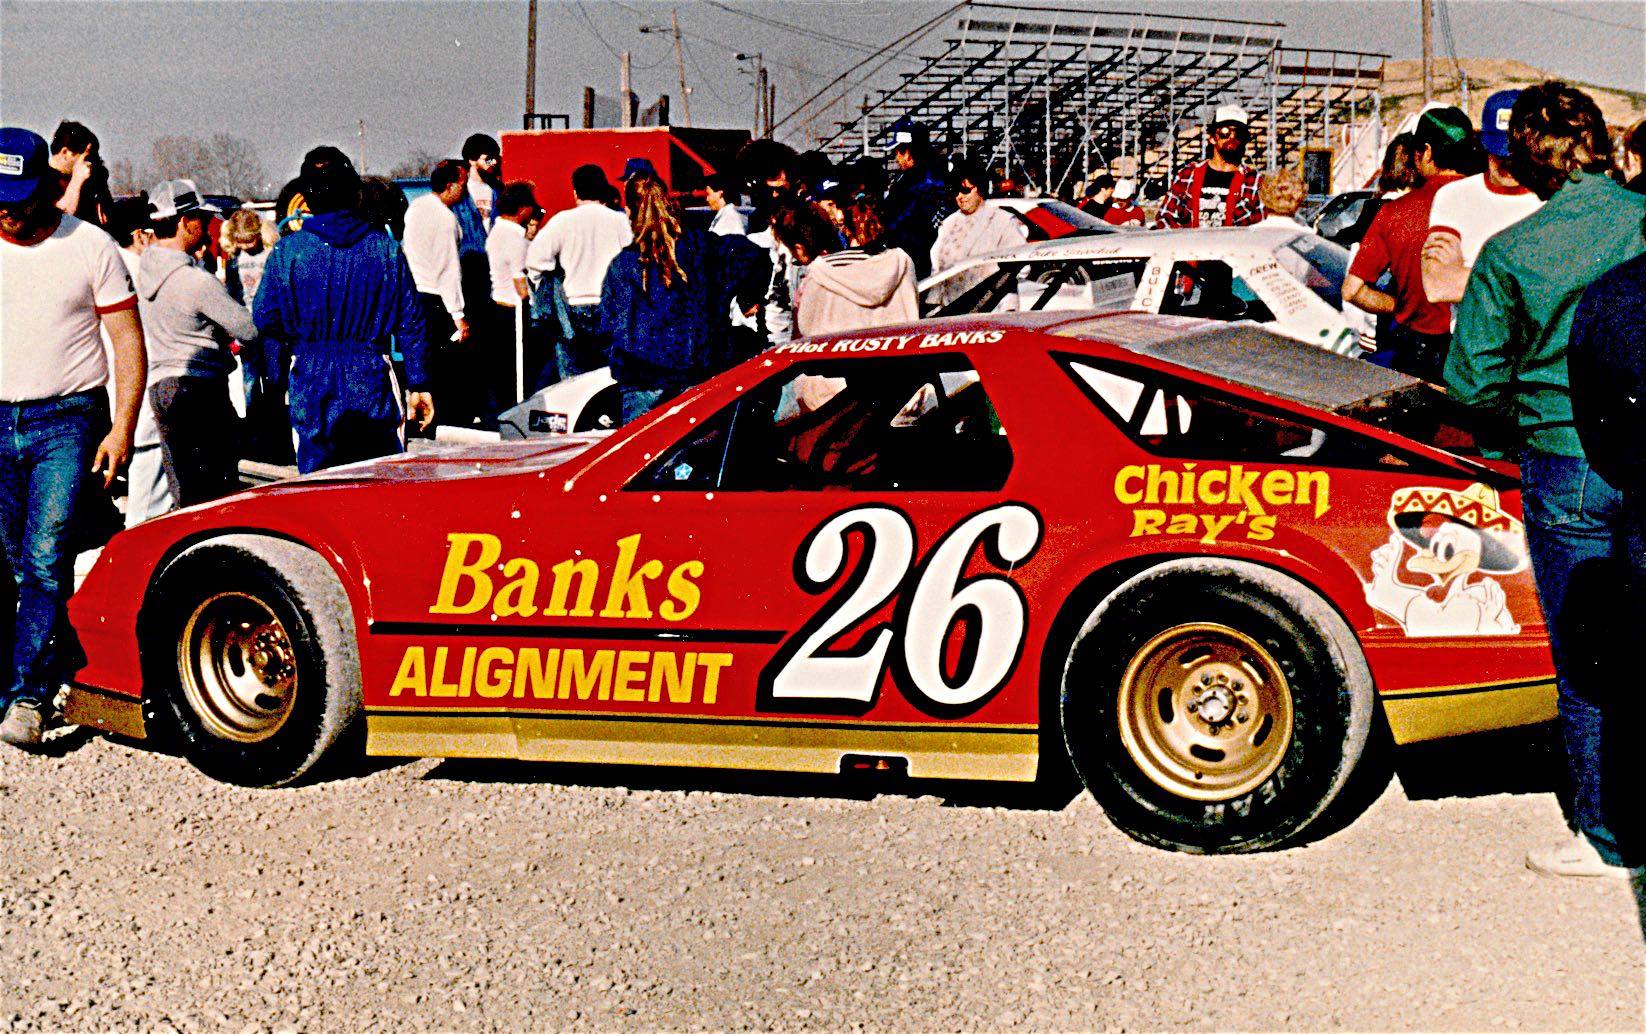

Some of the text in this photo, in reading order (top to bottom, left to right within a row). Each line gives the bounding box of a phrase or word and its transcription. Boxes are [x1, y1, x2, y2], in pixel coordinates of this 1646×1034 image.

[775, 330, 1007, 354] Pilot RUSTY BANKS
[1114, 463, 1331, 519] Chicken
[1129, 509, 1277, 545] Ray's
[429, 532, 704, 622] Banks
[763, 504, 1041, 713] 26
[389, 646, 734, 704] ALIGNMENT
